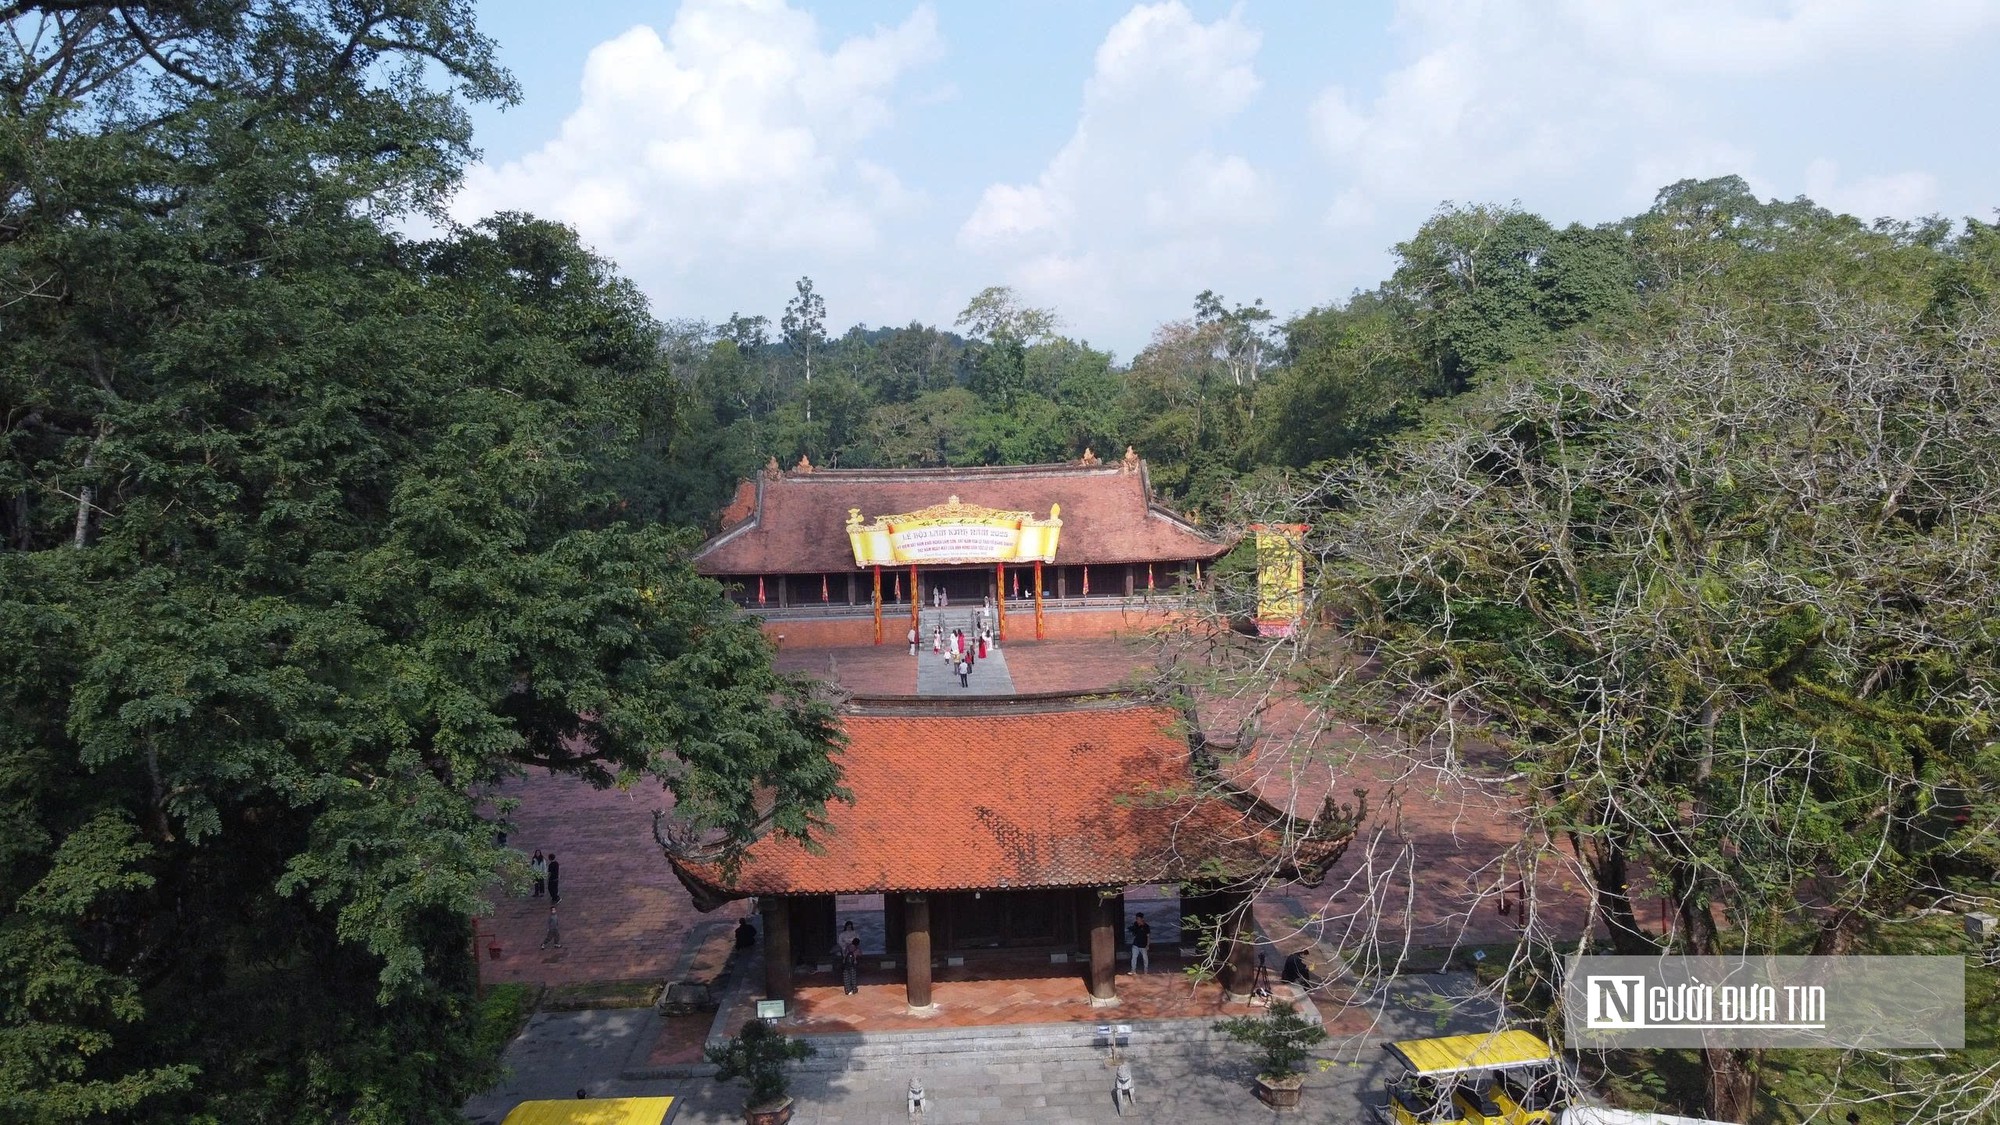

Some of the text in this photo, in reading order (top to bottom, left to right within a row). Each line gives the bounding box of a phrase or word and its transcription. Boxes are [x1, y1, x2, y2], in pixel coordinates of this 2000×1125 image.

[929, 529, 947, 538] LAM
[948, 528, 968, 537] KINH
[990, 530, 1009, 538] 2025
